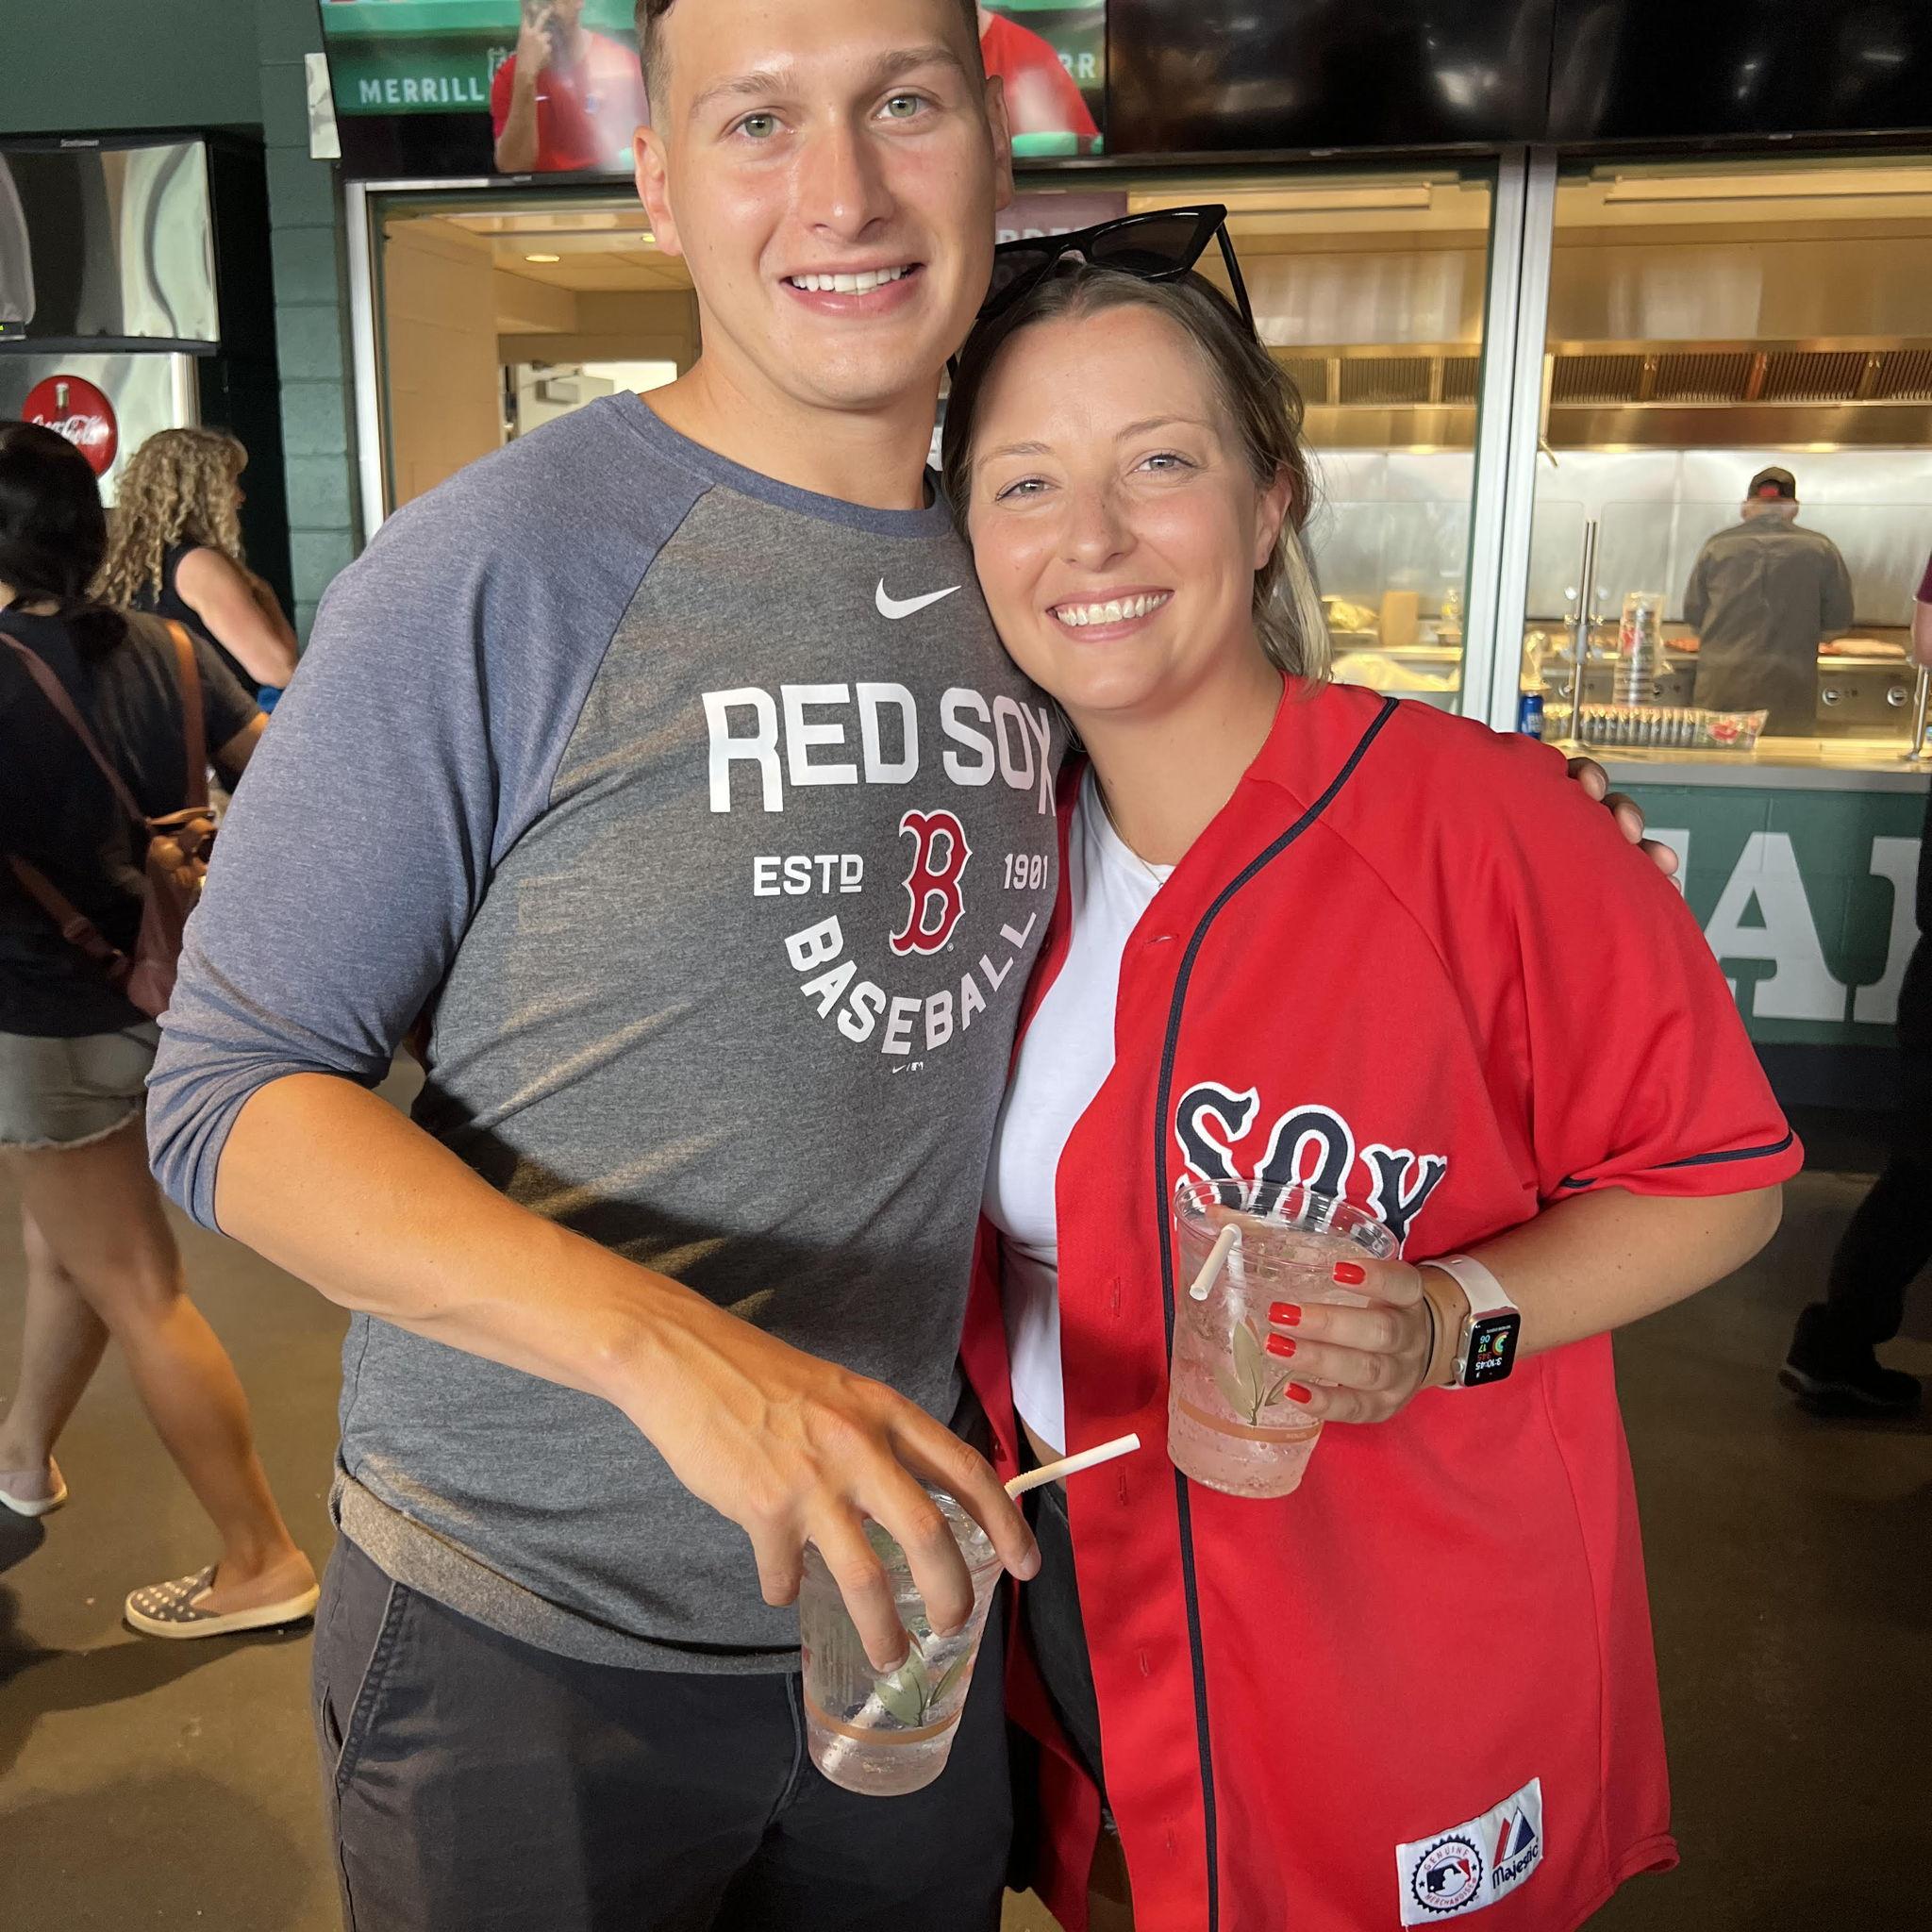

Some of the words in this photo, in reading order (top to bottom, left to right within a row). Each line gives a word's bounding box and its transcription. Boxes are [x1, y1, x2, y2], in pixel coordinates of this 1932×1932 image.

[358, 76, 486, 103] MERRILL
[702, 682, 920, 813] RED
[940, 687, 1056, 817] SOX
[754, 854, 864, 896] ESTD
[890, 808, 974, 956] B
[1004, 853, 1049, 890] 1901
[785, 911, 1037, 1055] BASEBALL
[1424, 1845, 1470, 1872] GENUINE
[1491, 1842, 1539, 1890] Majestic
[1424, 1883, 1474, 1907] MERCHANDISE
